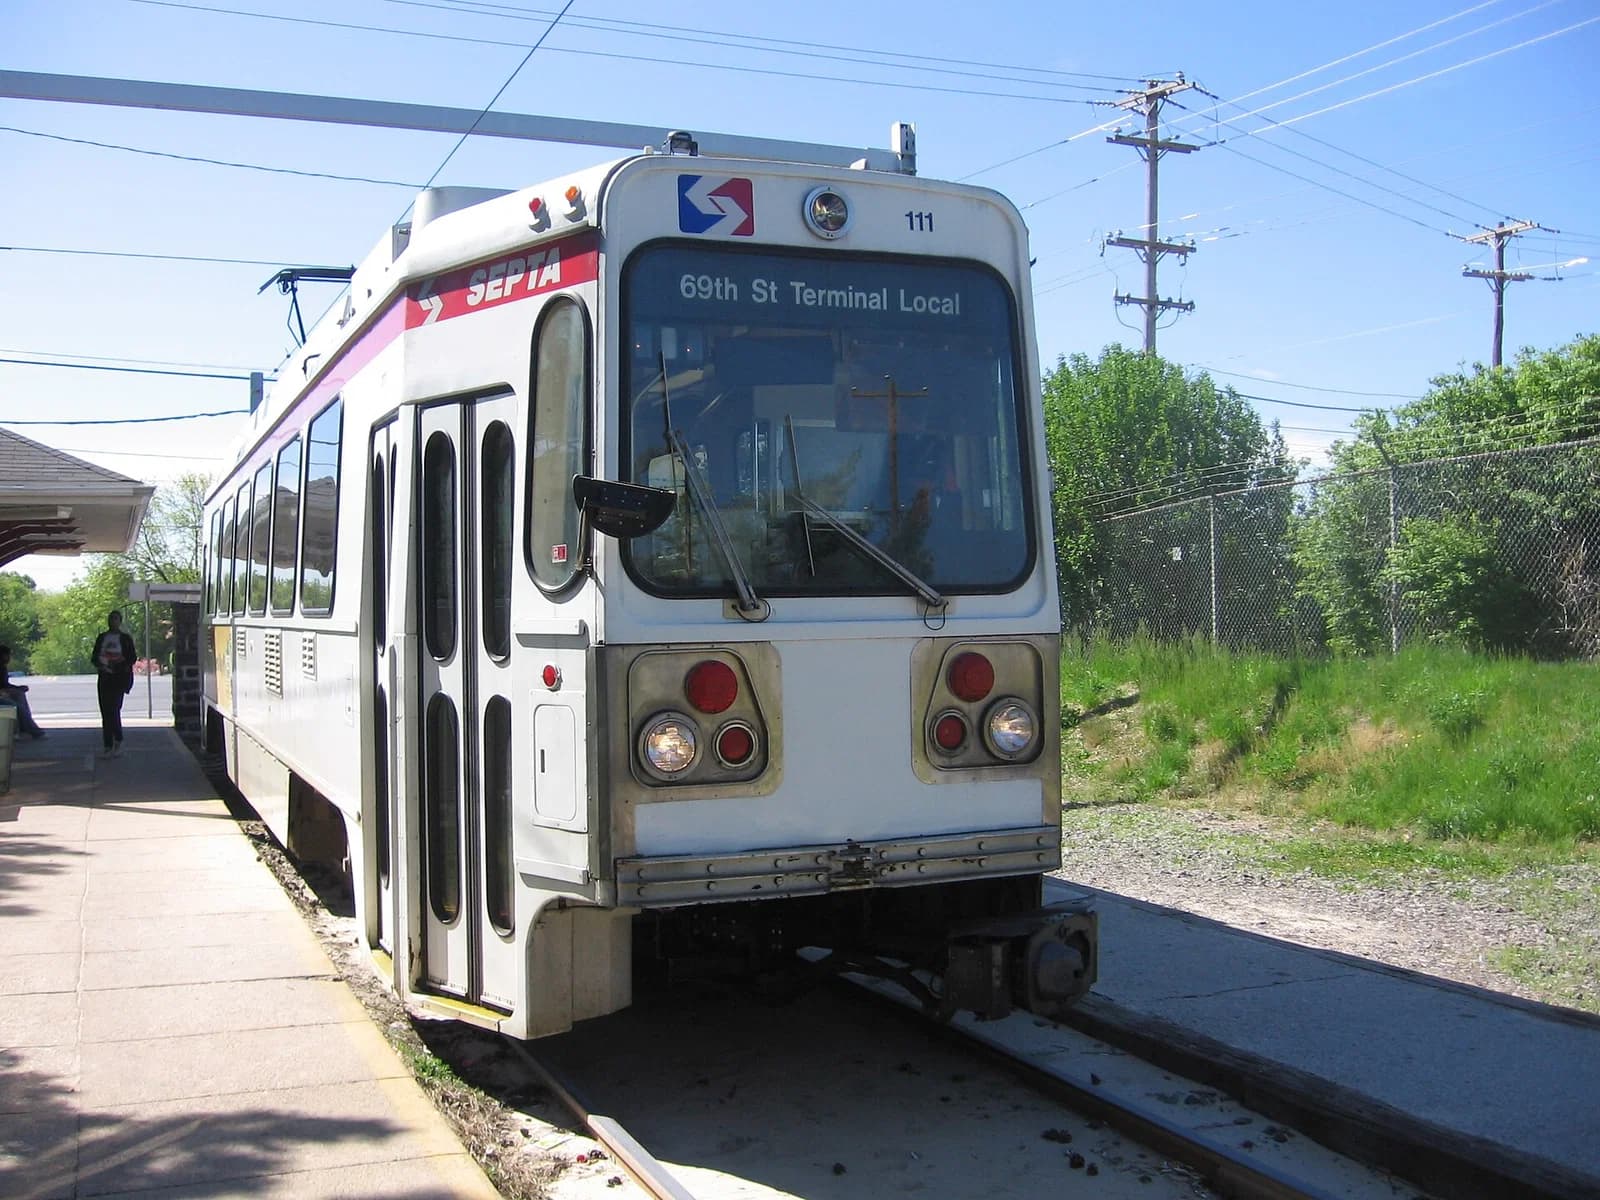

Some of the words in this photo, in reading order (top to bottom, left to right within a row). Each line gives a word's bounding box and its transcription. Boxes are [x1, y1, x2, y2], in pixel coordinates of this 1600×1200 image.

[905, 211, 933, 232] 111
[466, 248, 561, 306] SEPTA
[680, 274, 738, 301] 69th
[752, 279, 777, 303] St
[790, 281, 888, 310] Terminal
[900, 289, 960, 315] Local
